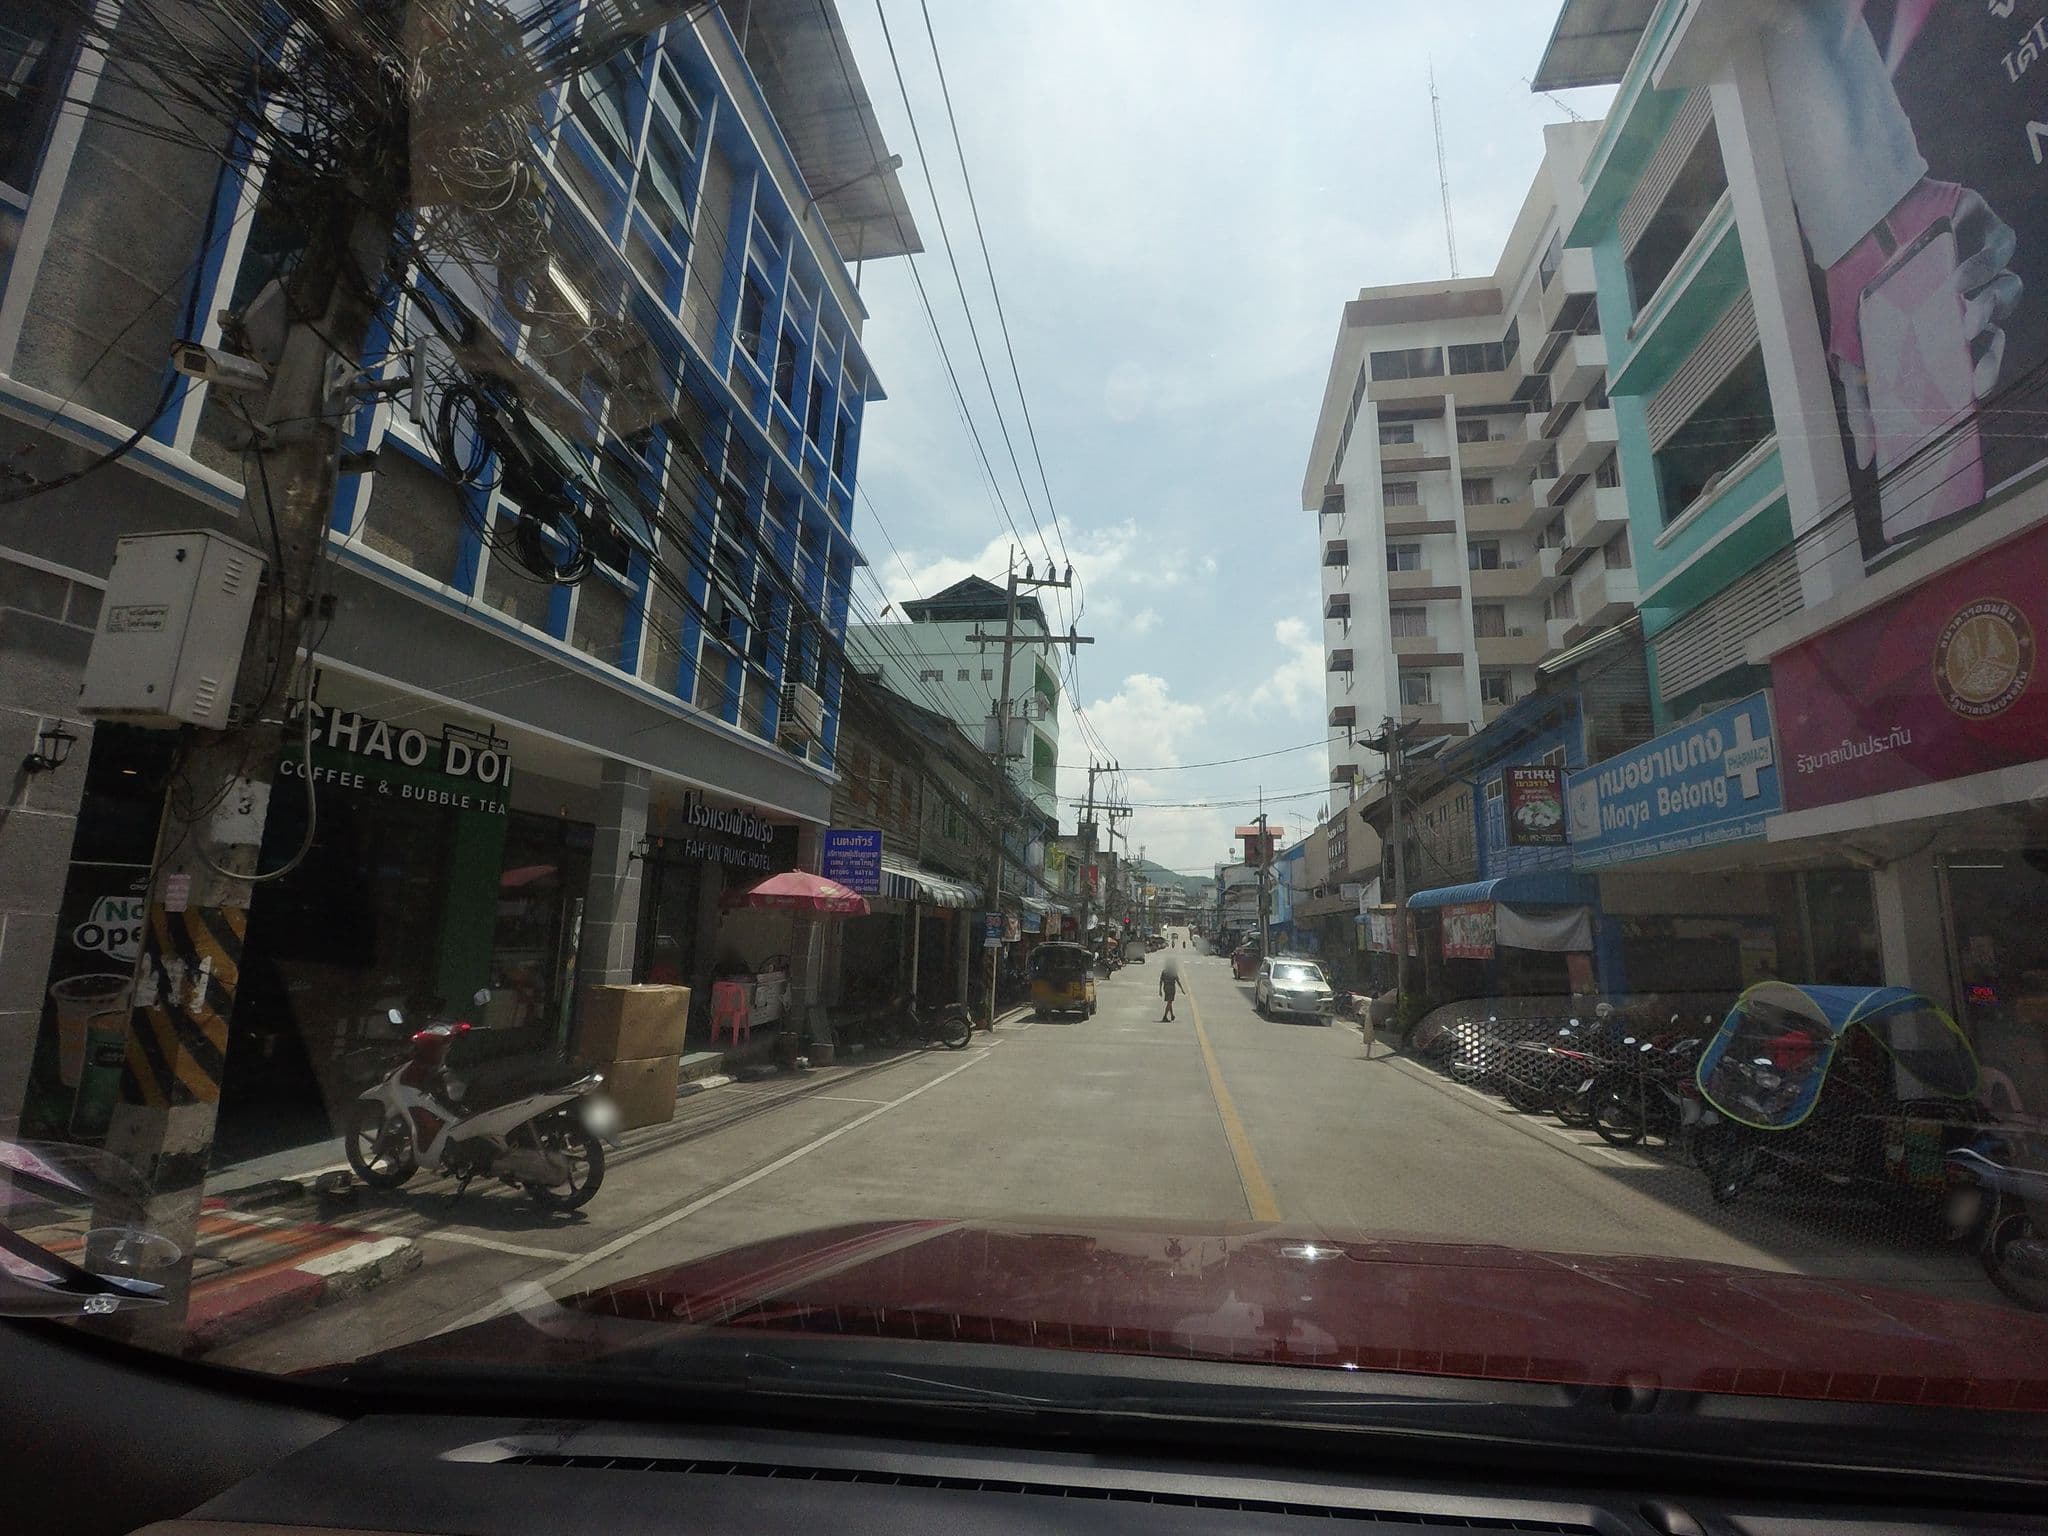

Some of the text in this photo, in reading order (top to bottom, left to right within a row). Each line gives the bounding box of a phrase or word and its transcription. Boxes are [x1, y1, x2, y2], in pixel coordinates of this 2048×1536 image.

[290, 700, 512, 787] CHAO DOI
[1599, 728, 1723, 799] หมอยาเบตง
[1796, 725, 1912, 774] รัฐบาลเป็นประกัน
[280, 760, 507, 816] COFFEE & BUBBLE TEA
[1602, 775, 1728, 830] Morya Betong
[685, 840, 771, 871] FAH UN RUNG HOTEL
[832, 835, 873, 847] เบตงทัวร์
